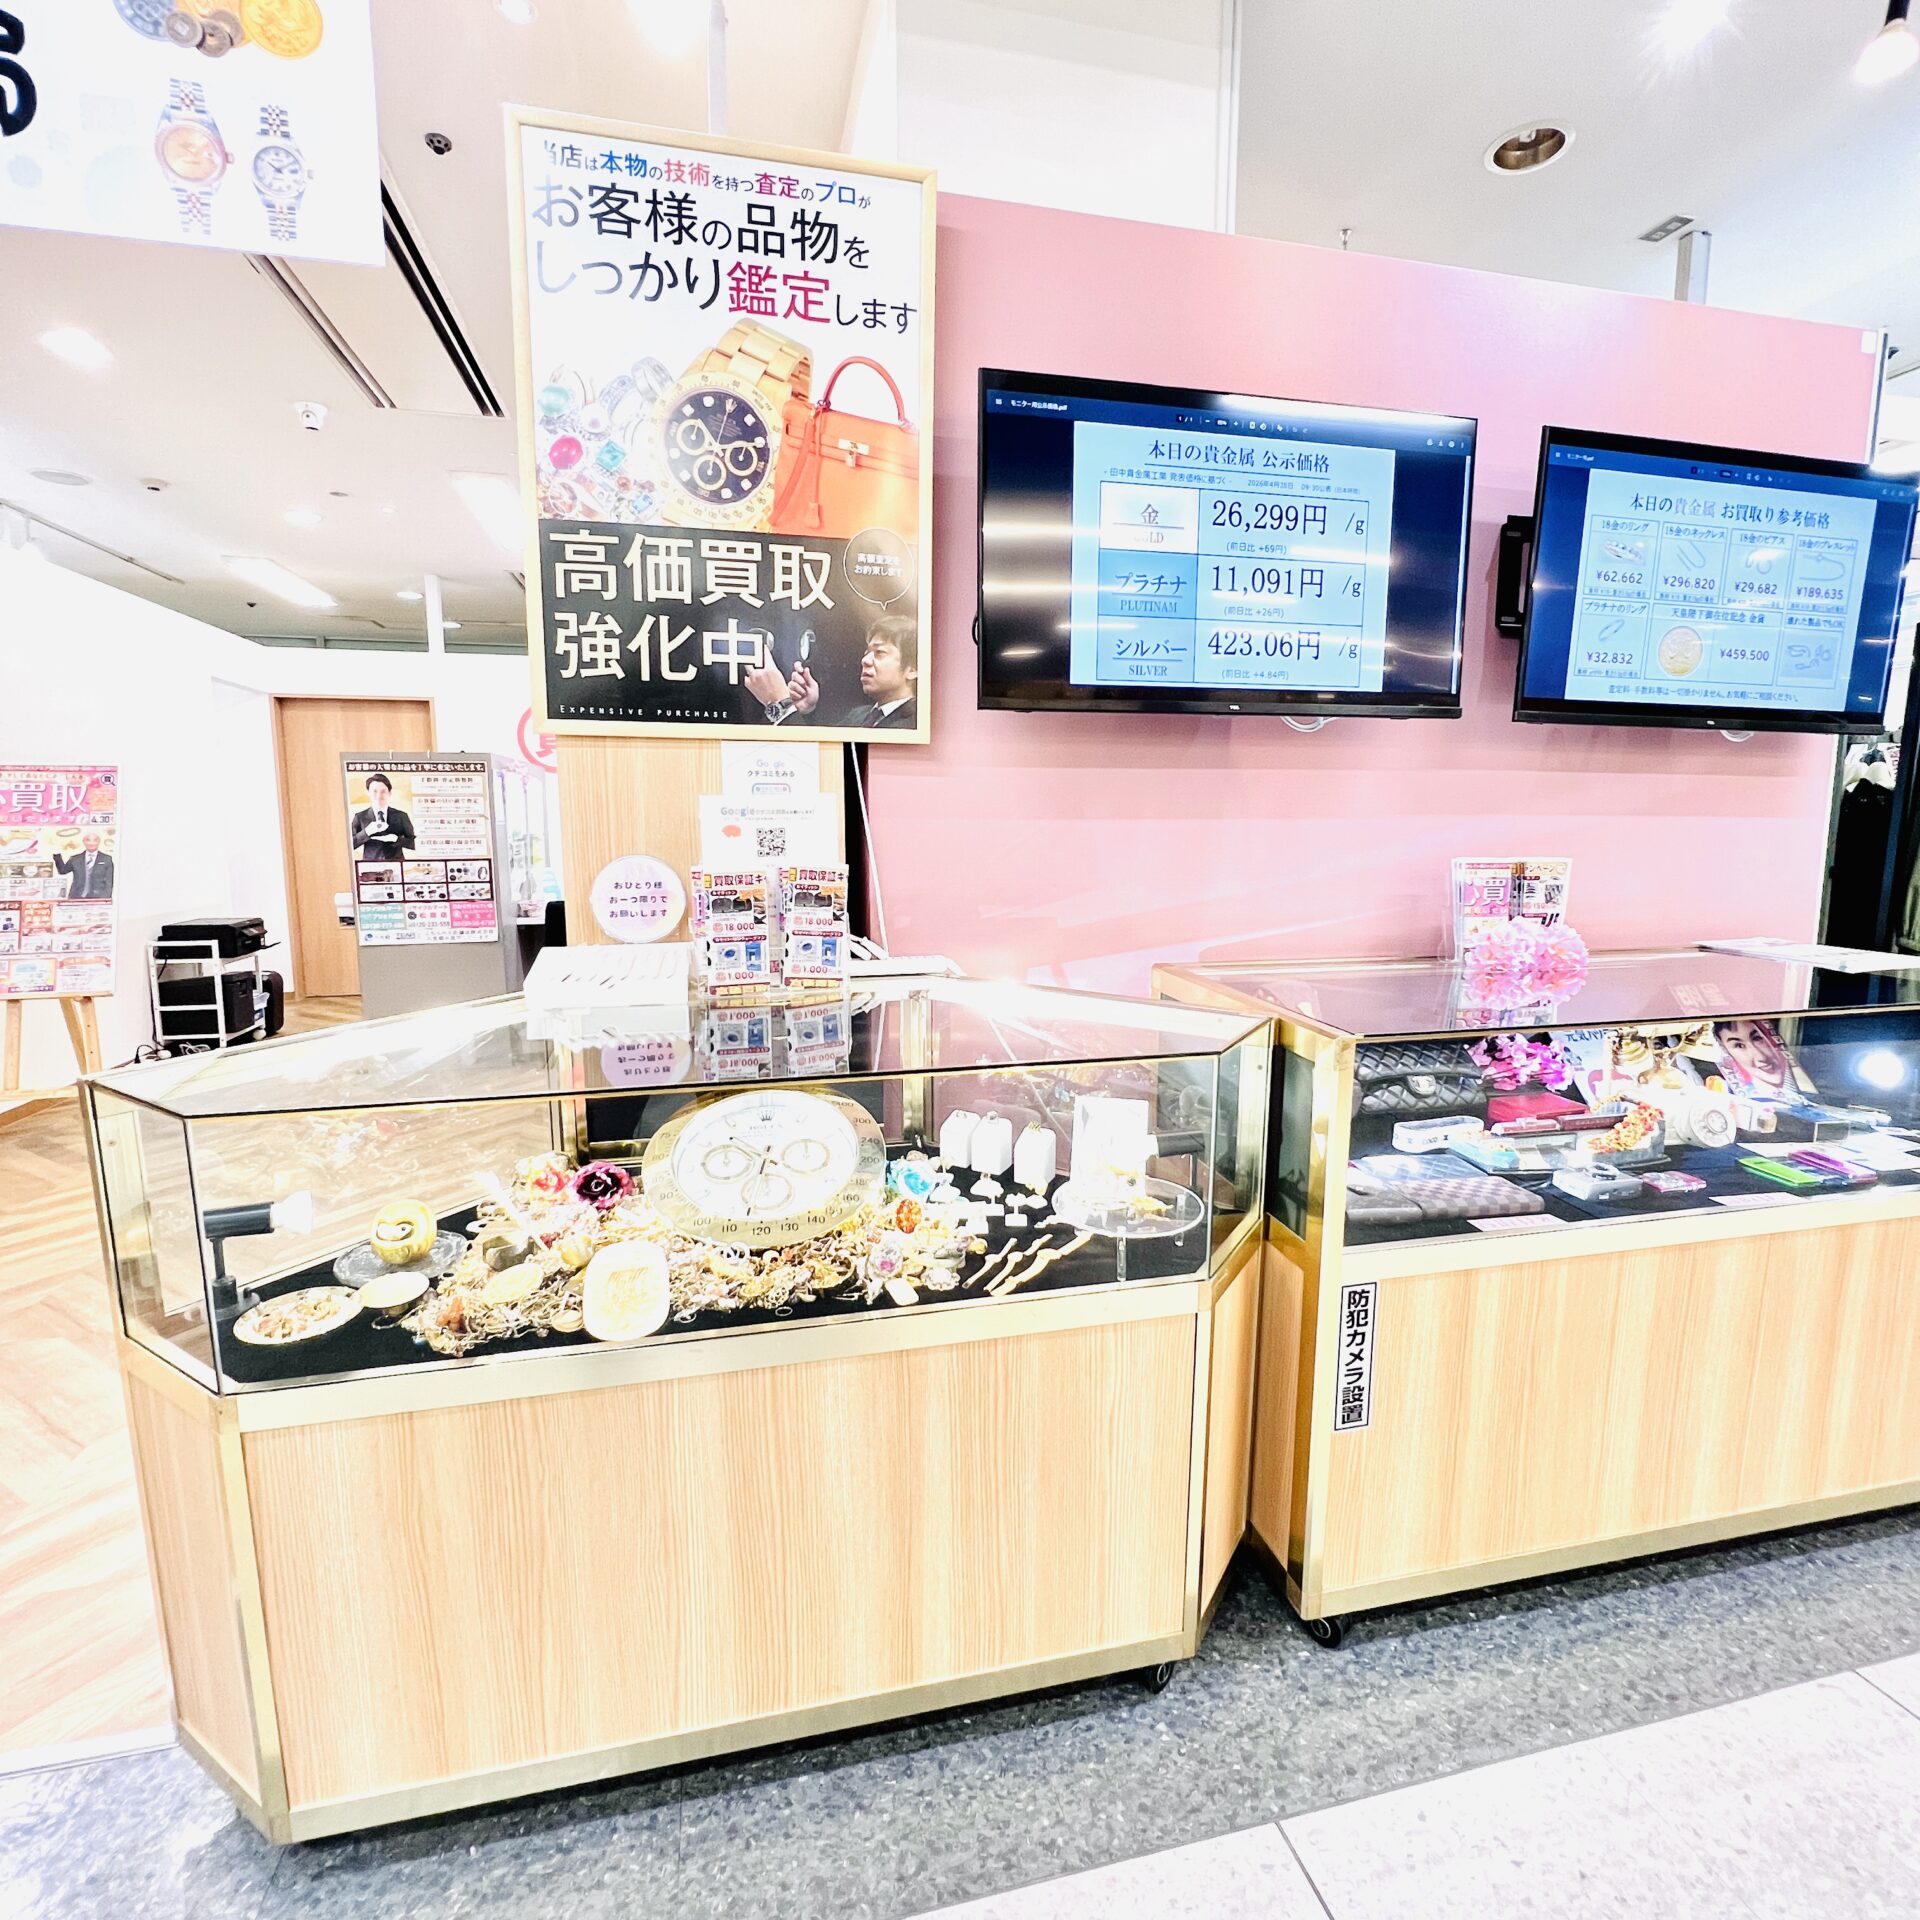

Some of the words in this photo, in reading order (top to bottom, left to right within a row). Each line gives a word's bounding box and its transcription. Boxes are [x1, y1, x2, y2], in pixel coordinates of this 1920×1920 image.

[544, 139, 871, 210] 当店は本物の技術を持つ査定のプロが
[531, 173, 870, 269] お客様の品物を
[536, 239, 918, 335] しっかり鑑定します
[1148, 439, 1255, 468] 本日の貴金属
[1262, 449, 1330, 474] 公示価格
[1140, 503, 1159, 525] 金
[1212, 500, 1327, 536] 26,299円
[1631, 492, 1715, 520] 本日の貴金属
[1720, 503, 1830, 529] お買取り参考価格
[549, 529, 835, 610] 高価買取
[1211, 566, 1325, 598] 11,091円
[1114, 573, 1187, 596] プラチナ
[554, 610, 766, 685] 強化中
[1115, 637, 1187, 658] シルバー
[1207, 630, 1321, 662] 423.06円
[1128, 663, 1168, 678] SILVER
[613, 881, 664, 890] おひとり様
[609, 895, 668, 904] お一つ限りで
[609, 910, 668, 919] お願いします
[721, 1224, 738, 1233] 110
[752, 1226, 771, 1236] 120
[780, 1222, 799, 1232] 130
[807, 1215, 826, 1224] 140
[1342, 1289, 1370, 1425] 防犯カメラ設置
